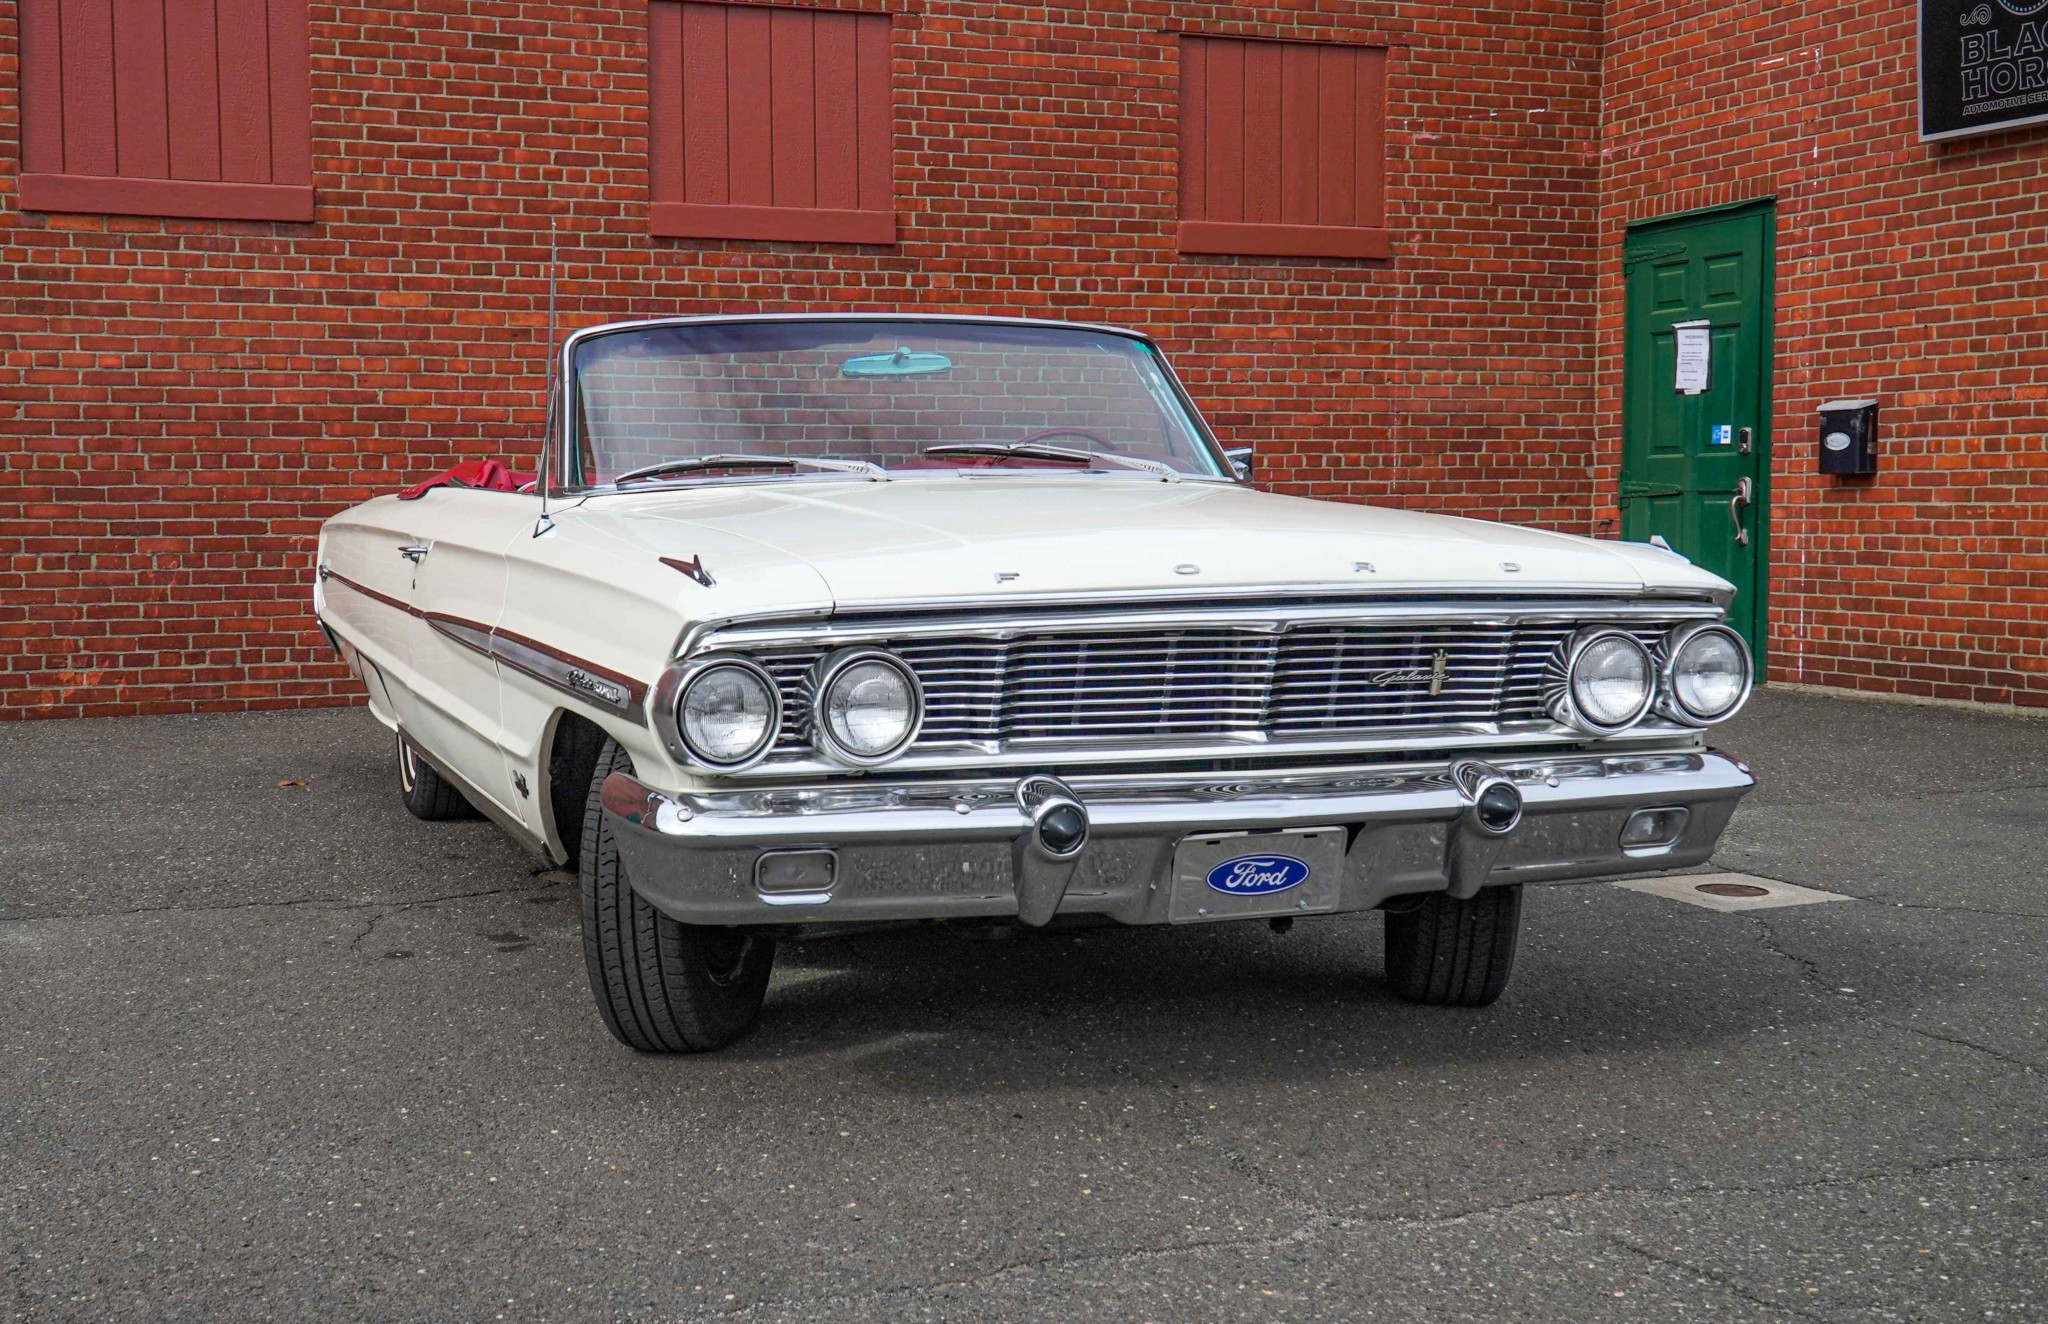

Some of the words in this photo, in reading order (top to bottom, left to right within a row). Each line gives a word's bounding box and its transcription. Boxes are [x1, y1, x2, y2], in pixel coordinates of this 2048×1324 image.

[1960, 20, 2048, 67] BLA
[1960, 56, 2048, 101] HOR
[1962, 94, 2027, 116] AUTOMOTIVE
[994, 561, 1521, 584] FORD
[1372, 669, 1450, 687] Galaxie
[1225, 860, 1290, 889] Ford
